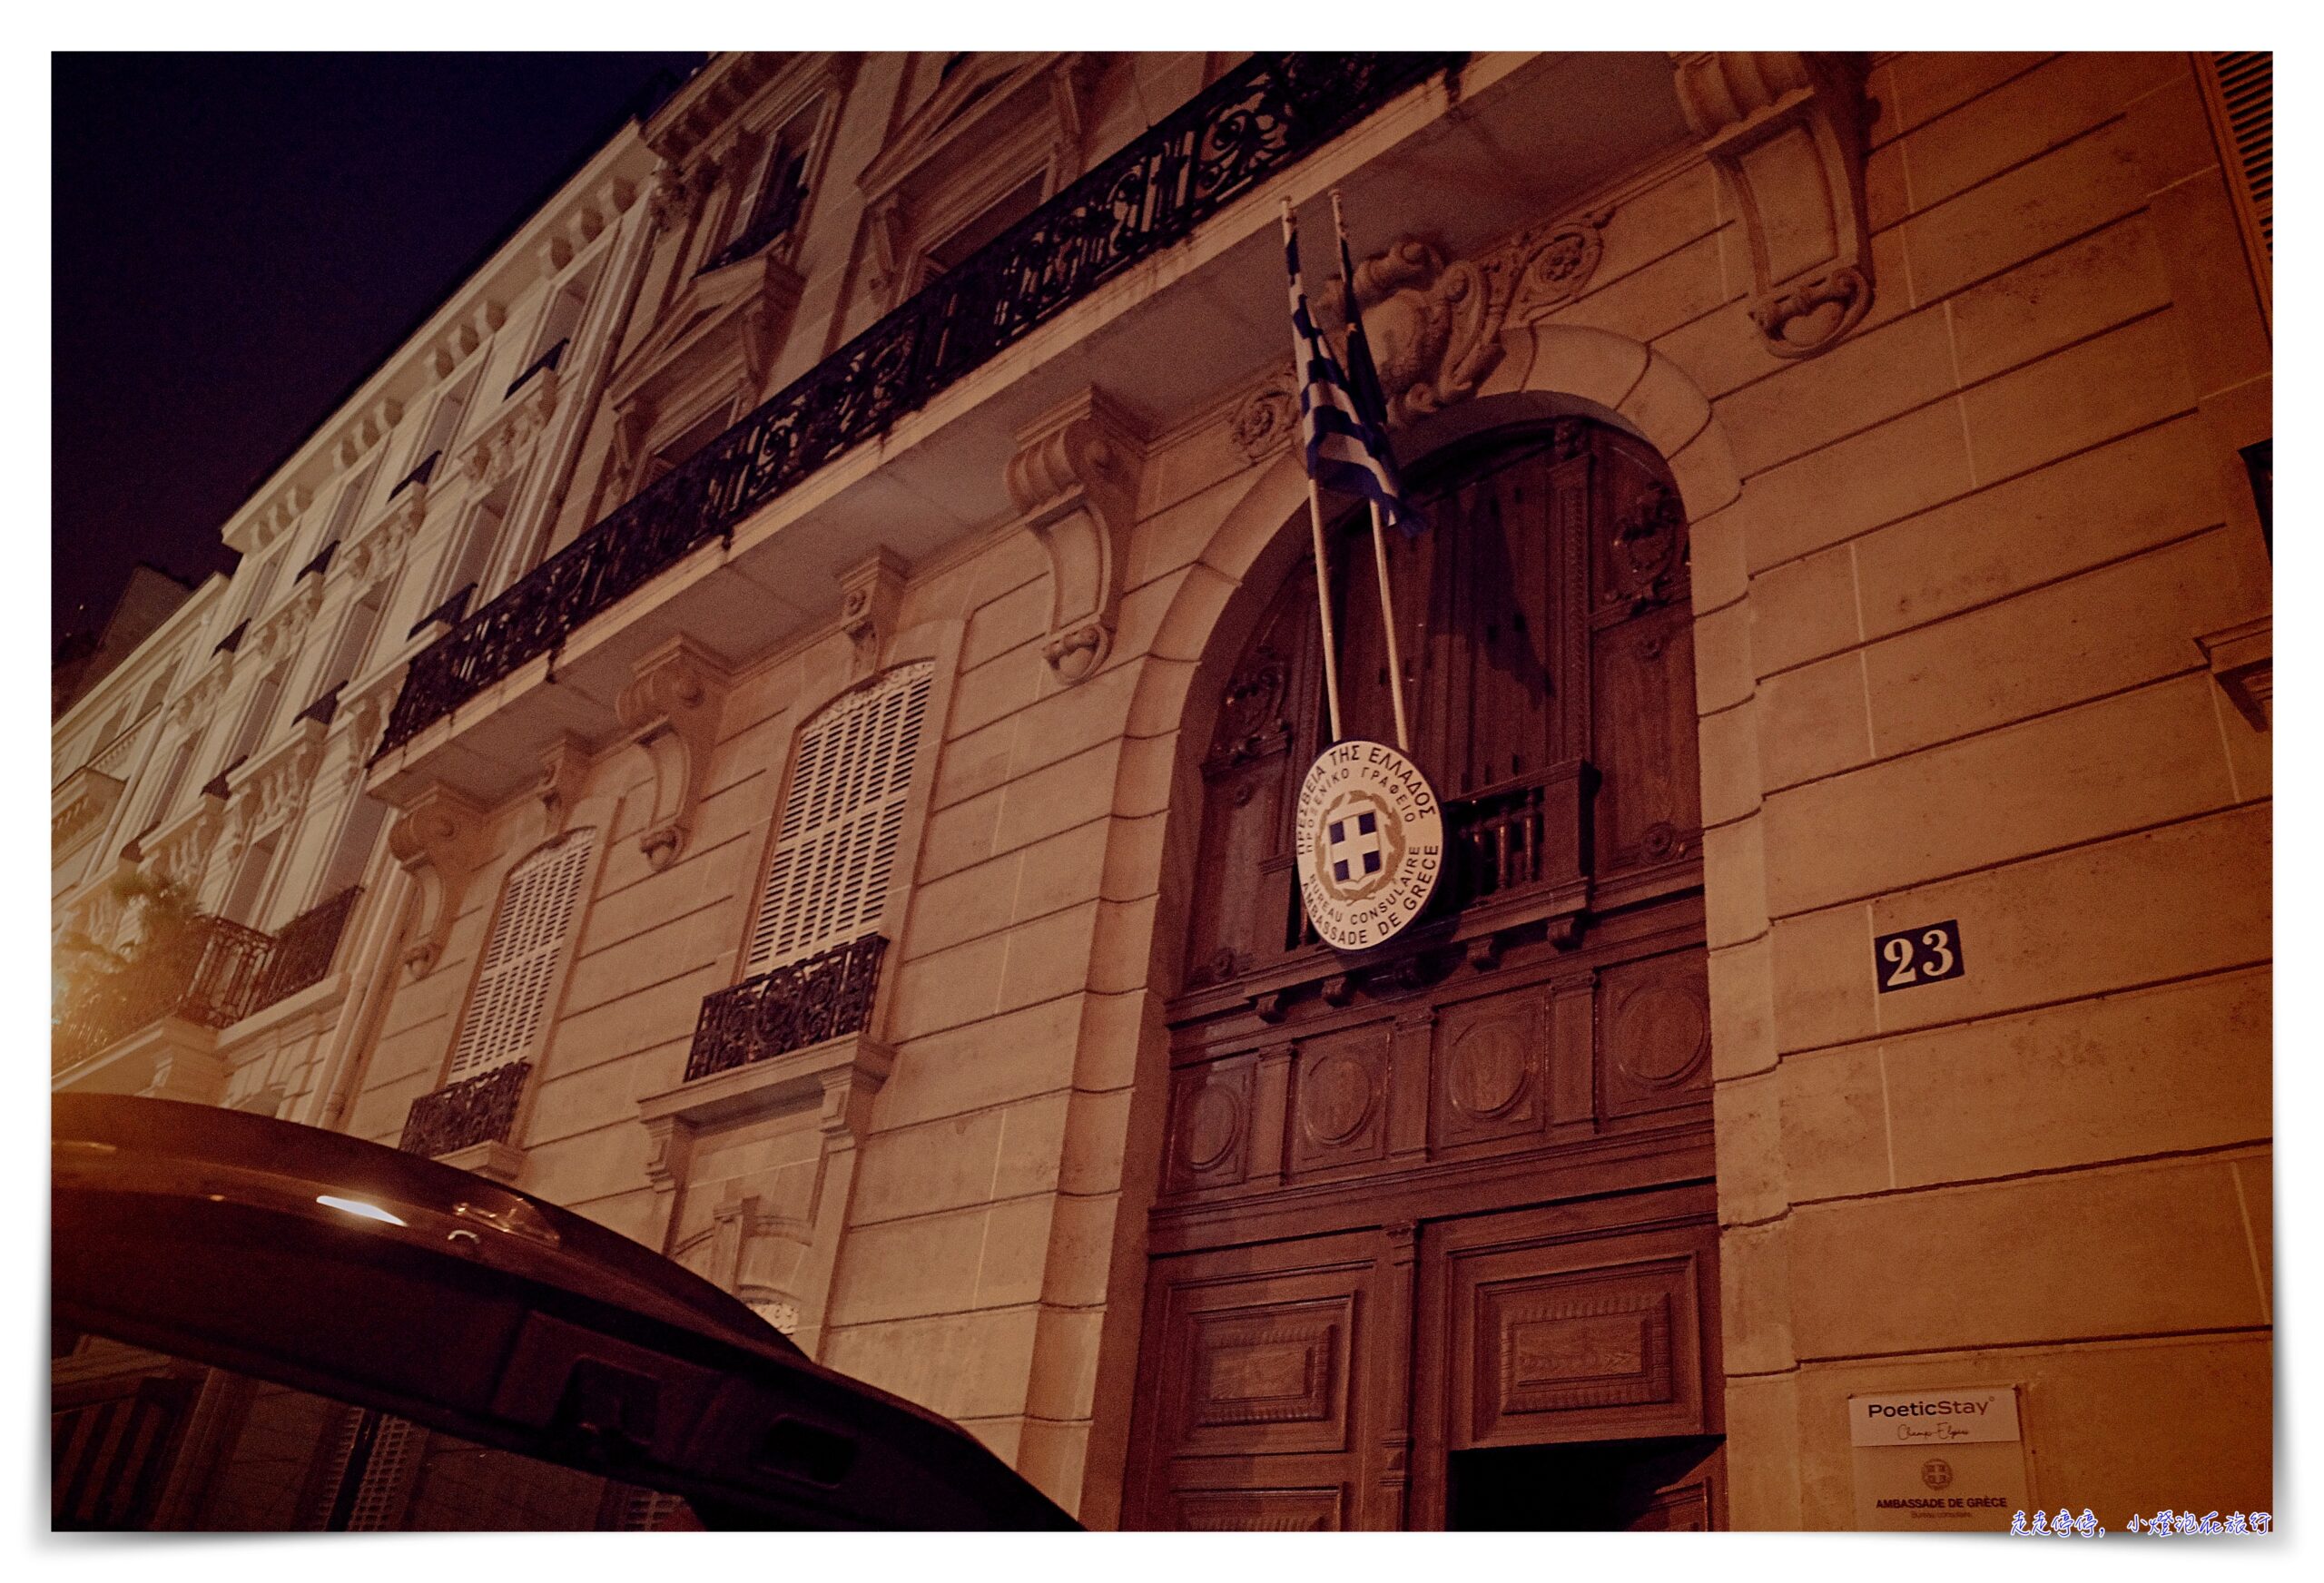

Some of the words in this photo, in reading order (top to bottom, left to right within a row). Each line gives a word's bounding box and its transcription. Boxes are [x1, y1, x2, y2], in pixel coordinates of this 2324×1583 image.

[1297, 765, 1325, 855] ΠΡΕΣΒΕΙΑ
[1329, 744, 1361, 766] ΤΗΣ
[1368, 747, 1436, 819] ΕΛΛΑΔΟΣ
[1302, 882, 1367, 945] AMBASSADE
[1378, 912, 1402, 936] DE
[1403, 845, 1439, 911] GRECE
[1309, 873, 1344, 922] BUREAU
[1350, 846, 1420, 925] CONSULAIRE
[1884, 929, 1954, 987] 23
[1876, 1499, 1945, 1509] AMBASSADE
[1948, 1498, 1965, 1508] DE
